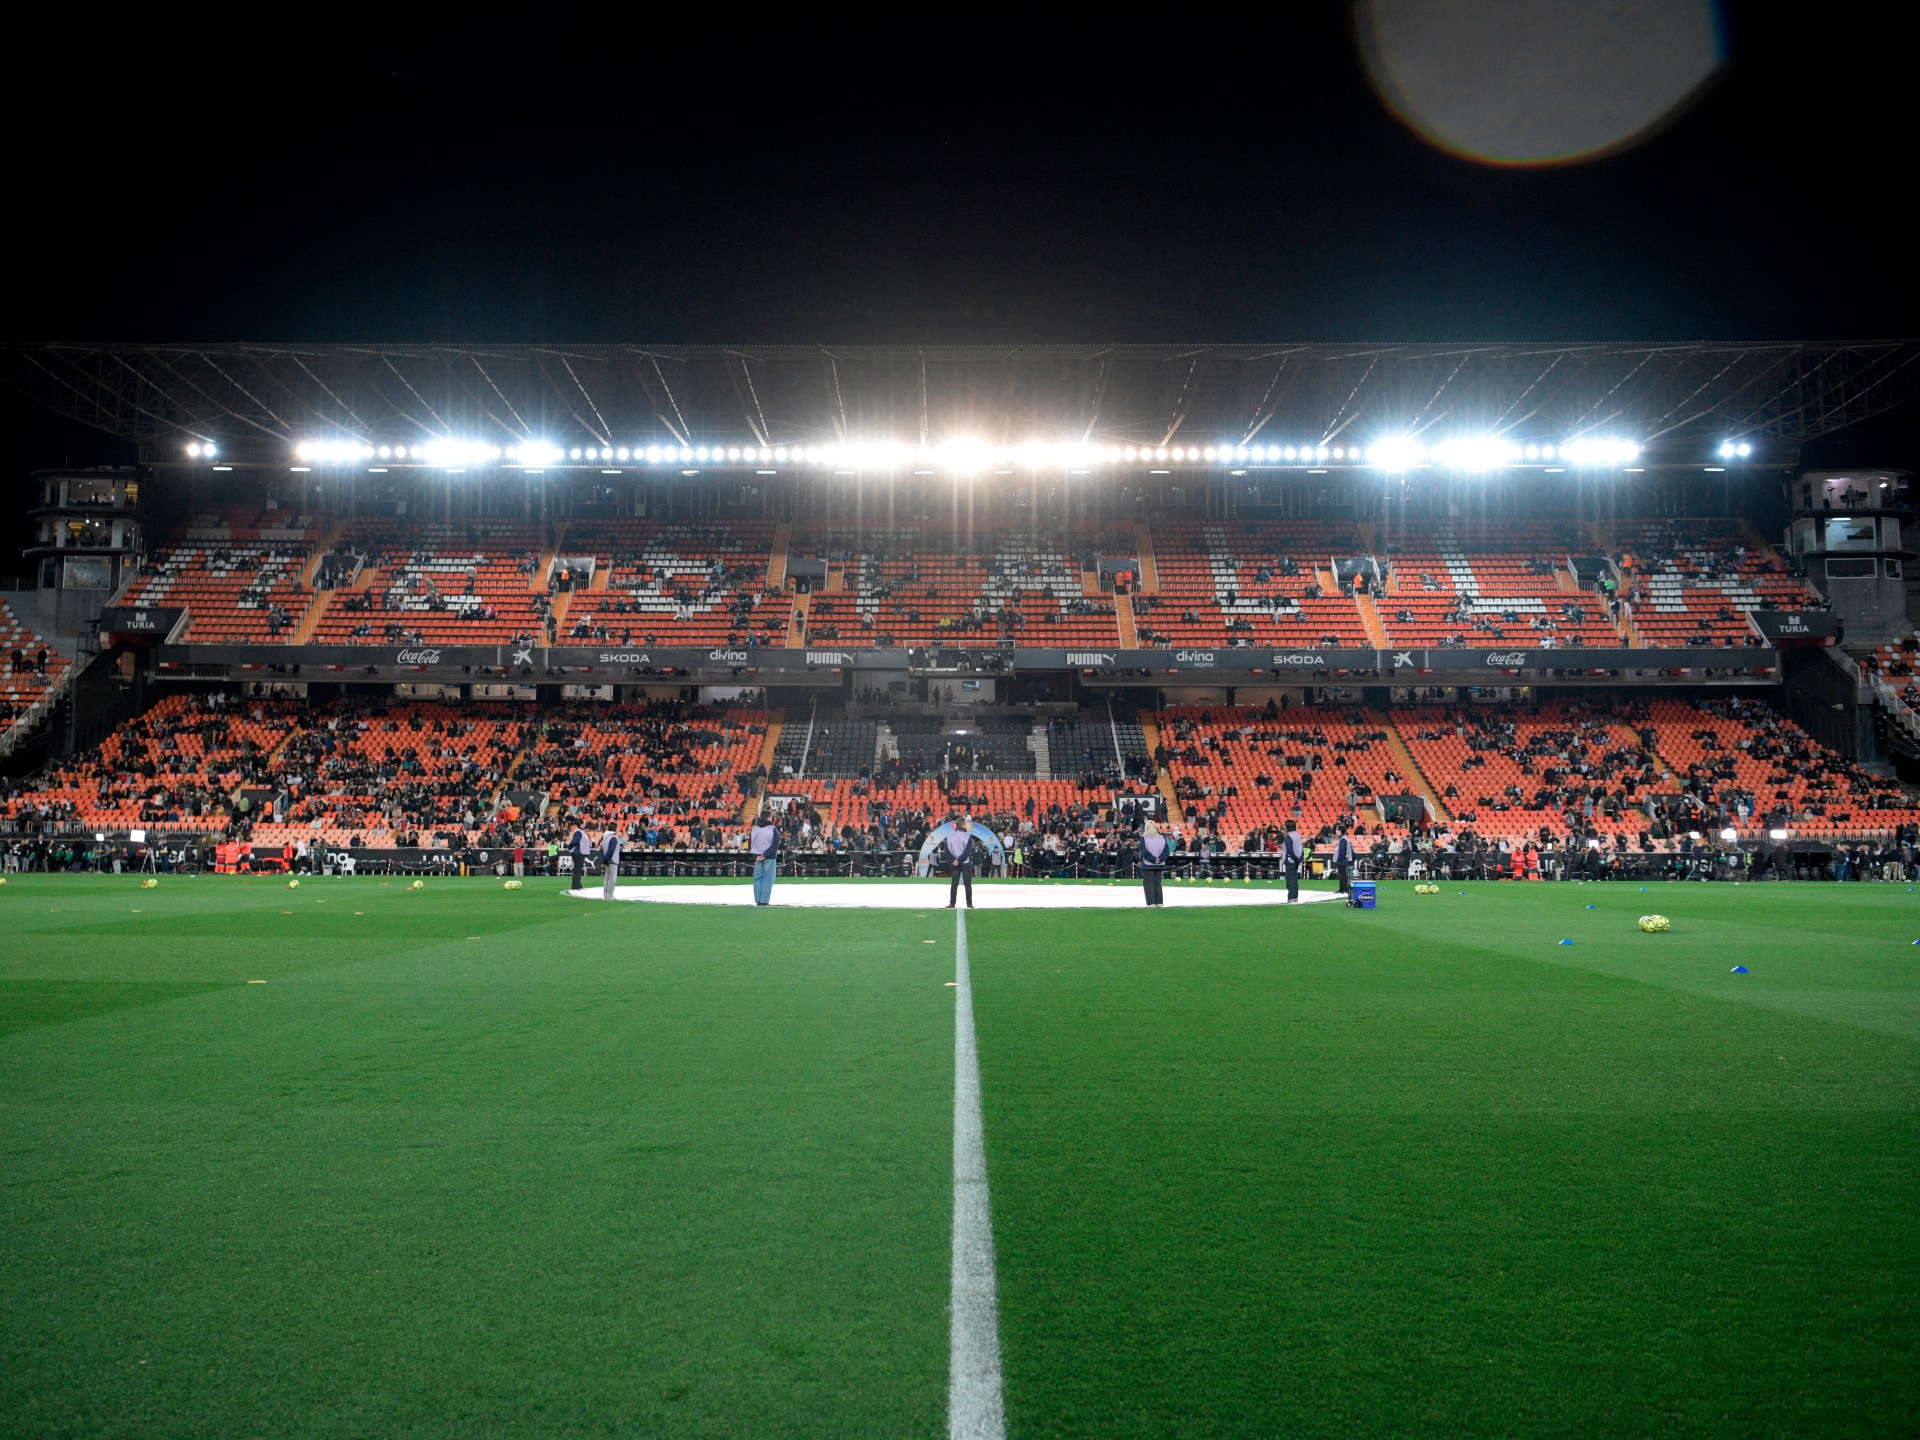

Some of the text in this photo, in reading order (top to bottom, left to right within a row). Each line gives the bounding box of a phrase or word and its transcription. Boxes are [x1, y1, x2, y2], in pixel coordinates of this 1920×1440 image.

[126, 621, 155, 629] TURIA
[1779, 625, 1810, 633] TURIA
[397, 649, 442, 664] Coca-Cola
[709, 649, 747, 661] divina
[806, 652, 842, 664] PUMA
[1066, 653, 1103, 665] PUMA
[1176, 650, 1214, 662] divina
[1486, 652, 1527, 666] Coca-Cola
